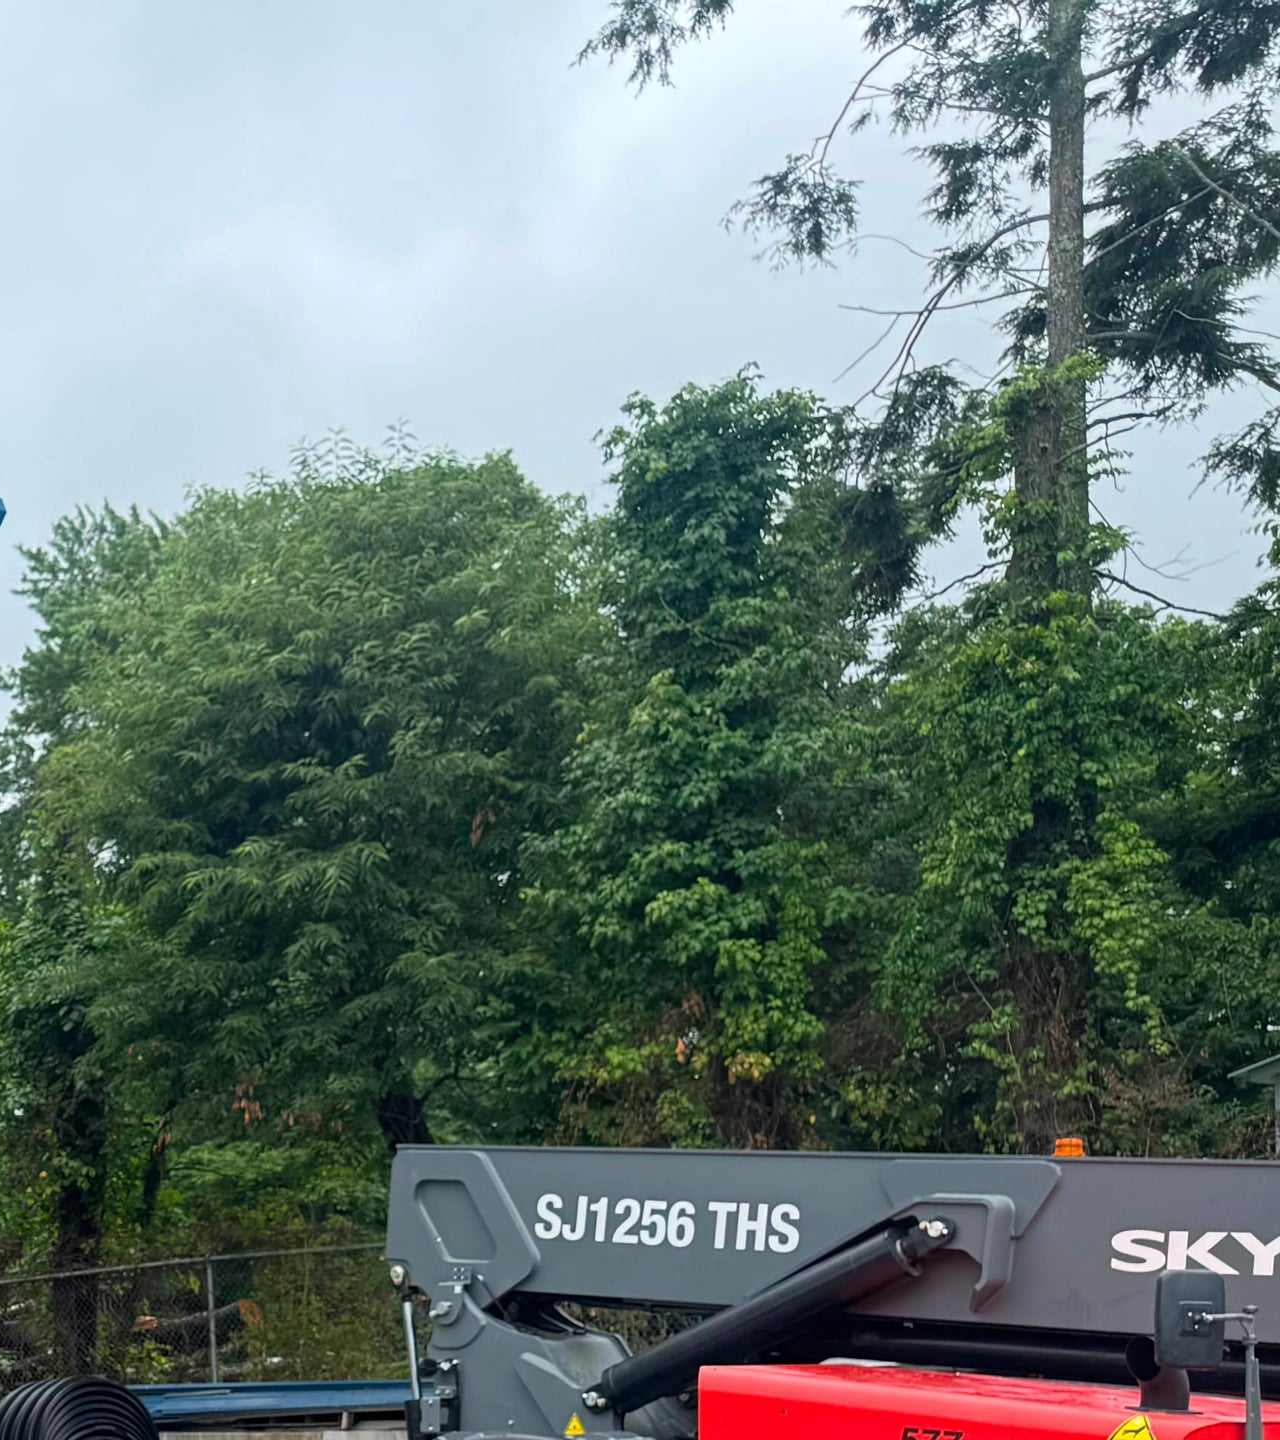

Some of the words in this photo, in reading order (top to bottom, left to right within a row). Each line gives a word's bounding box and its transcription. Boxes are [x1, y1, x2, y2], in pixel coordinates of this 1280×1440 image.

[534, 1194, 696, 1248] SJ1256
[708, 1201, 801, 1253] THS
[1110, 1229, 1280, 1276] SKY
